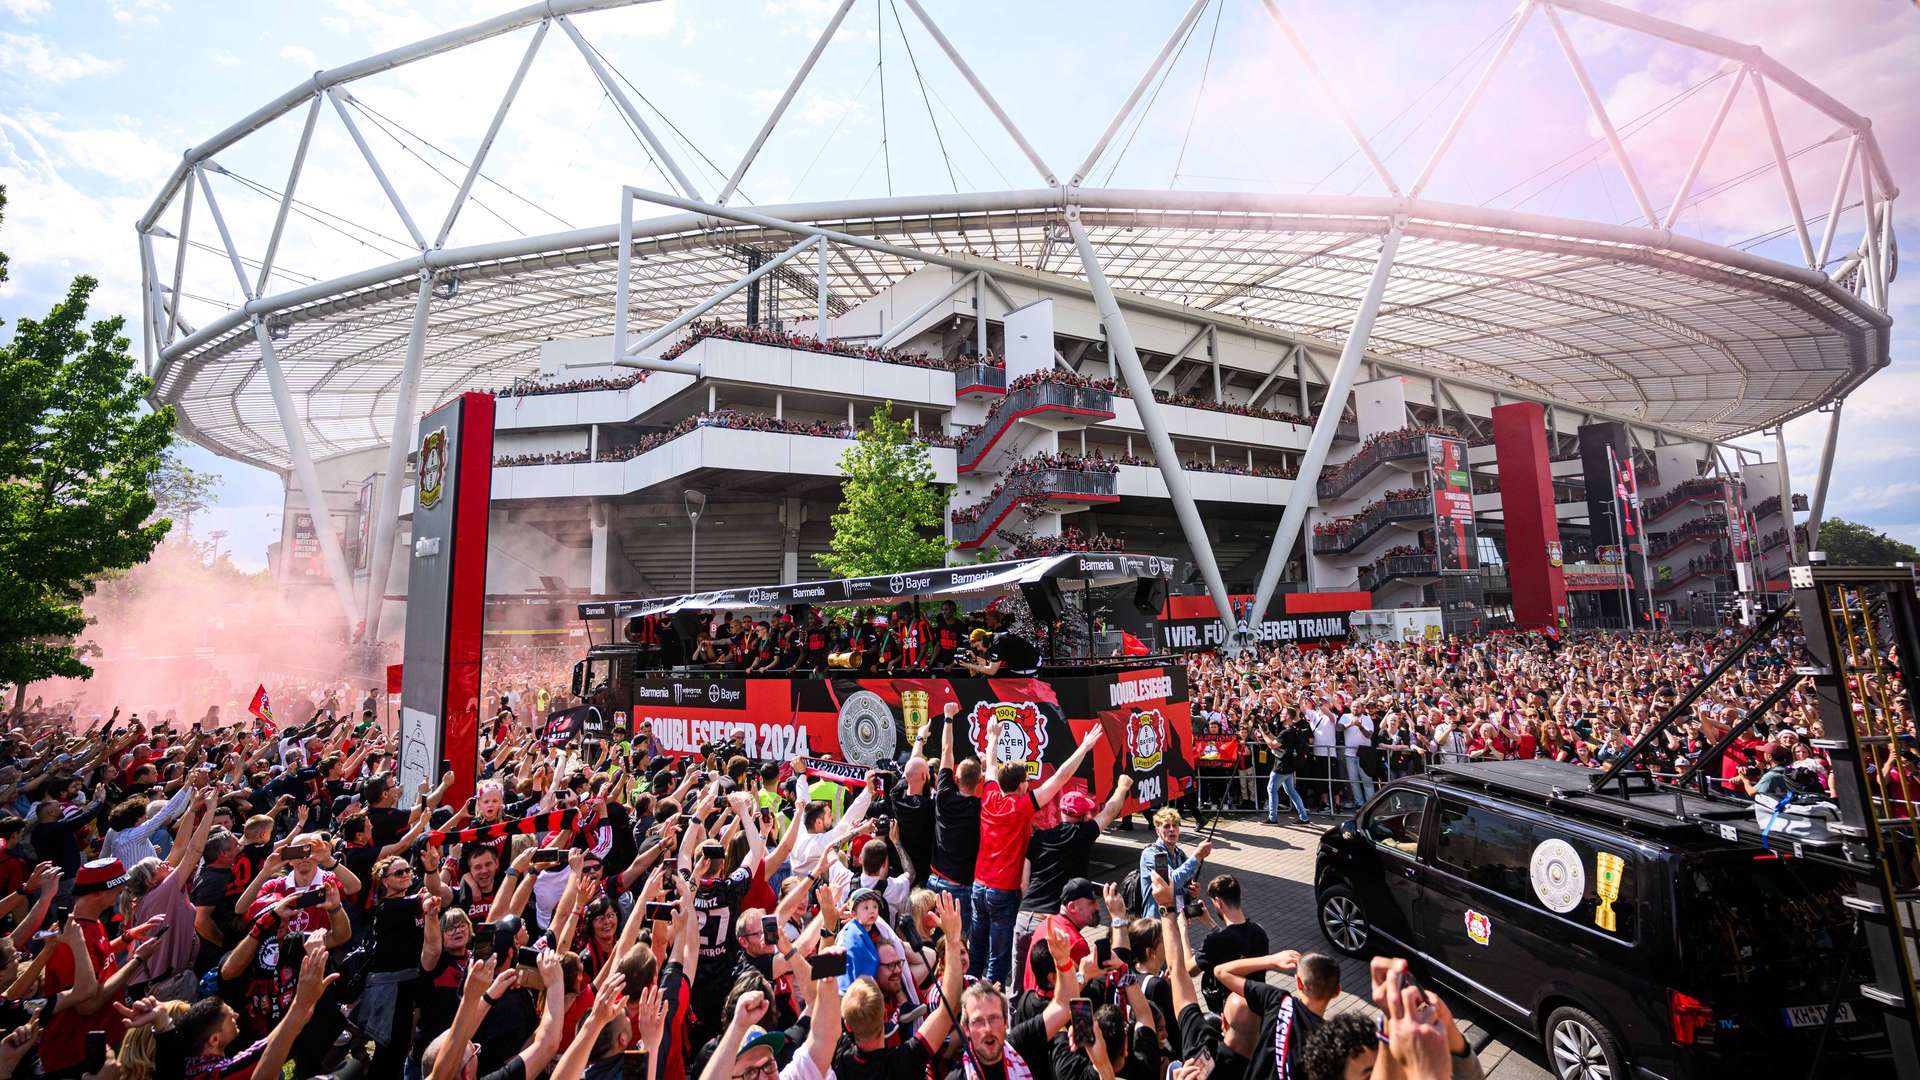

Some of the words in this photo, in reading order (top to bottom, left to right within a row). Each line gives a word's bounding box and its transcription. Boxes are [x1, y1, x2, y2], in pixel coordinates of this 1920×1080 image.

[1080, 558, 1114, 571] Barmenia
[1160, 561, 1174, 575] Bayr
[905, 576, 931, 589] Bayer
[951, 571, 994, 585] Barmenia
[760, 591, 779, 602] Bayer
[792, 586, 825, 598] Barmenia
[1164, 625, 1202, 647] WIR.
[1203, 619, 1224, 645] FÜ
[1255, 620, 1297, 641] SEREN
[1298, 618, 1346, 638] TRAUM.
[640, 687, 669, 698] Barmenia
[721, 688, 740, 702] Bayer
[1110, 676, 1172, 707] DOUBLESIEGER
[997, 708, 1014, 718] 1904
[584, 721, 601, 730] MAN
[644, 717, 758, 759] DOUBLESIEGR
[760, 723, 810, 762] 2024
[1003, 722, 1012, 761] BAYER
[1138, 775, 1162, 804] 2024
[694, 897, 718, 908] WIRTZ
[696, 906, 731, 946] 27
